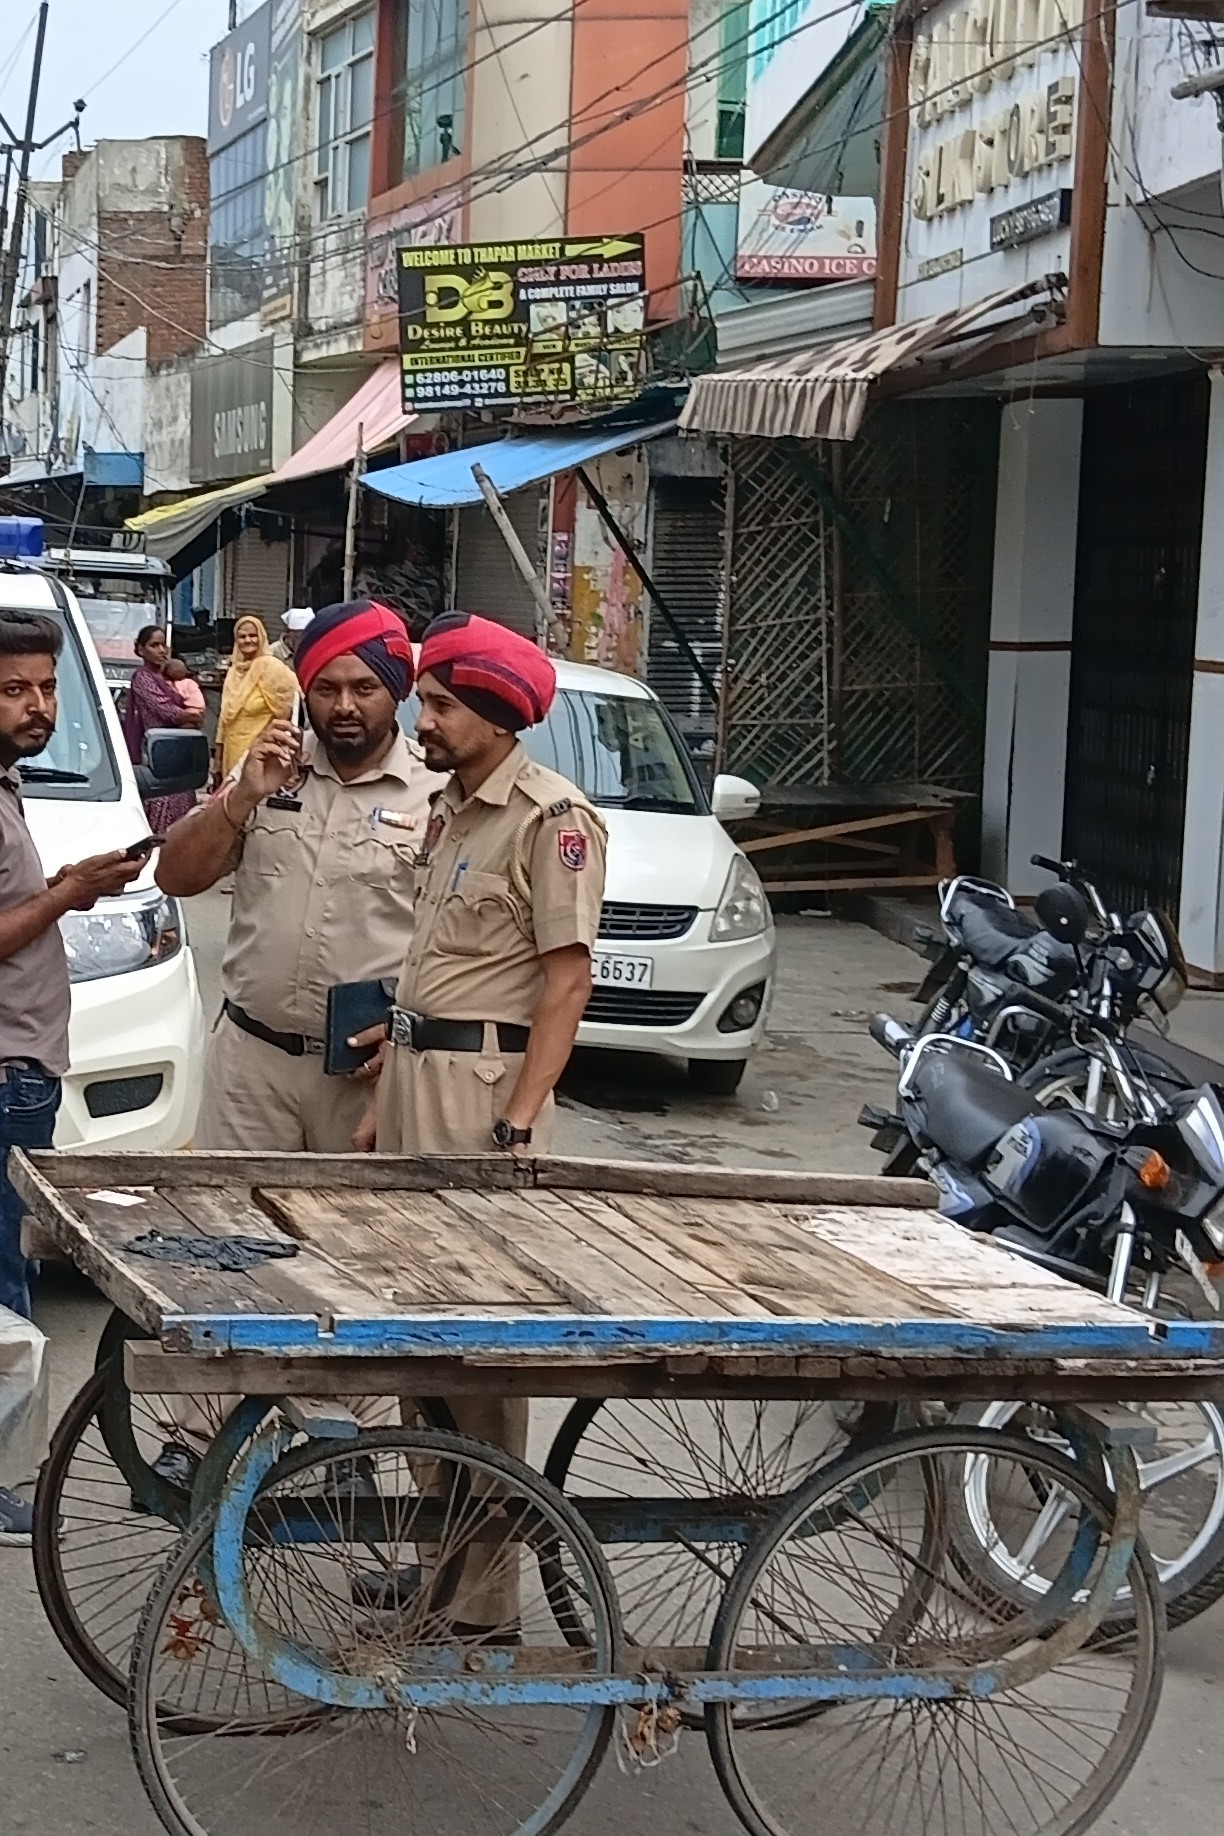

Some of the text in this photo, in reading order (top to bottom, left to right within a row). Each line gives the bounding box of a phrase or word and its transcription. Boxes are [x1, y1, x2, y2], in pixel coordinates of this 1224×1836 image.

[235, 42, 255, 109] LG
[401, 249, 456, 268] WELCOME
[457, 248, 473, 265] TO
[517, 243, 561, 261] MARKET
[742, 257, 819, 275] CASINO
[823, 258, 858, 275] ICE
[559, 264, 591, 280] FOR
[592, 261, 643, 278] LADIES
[528, 286, 575, 300] COMPLETE
[214, 401, 266, 458] SAMSUNG
